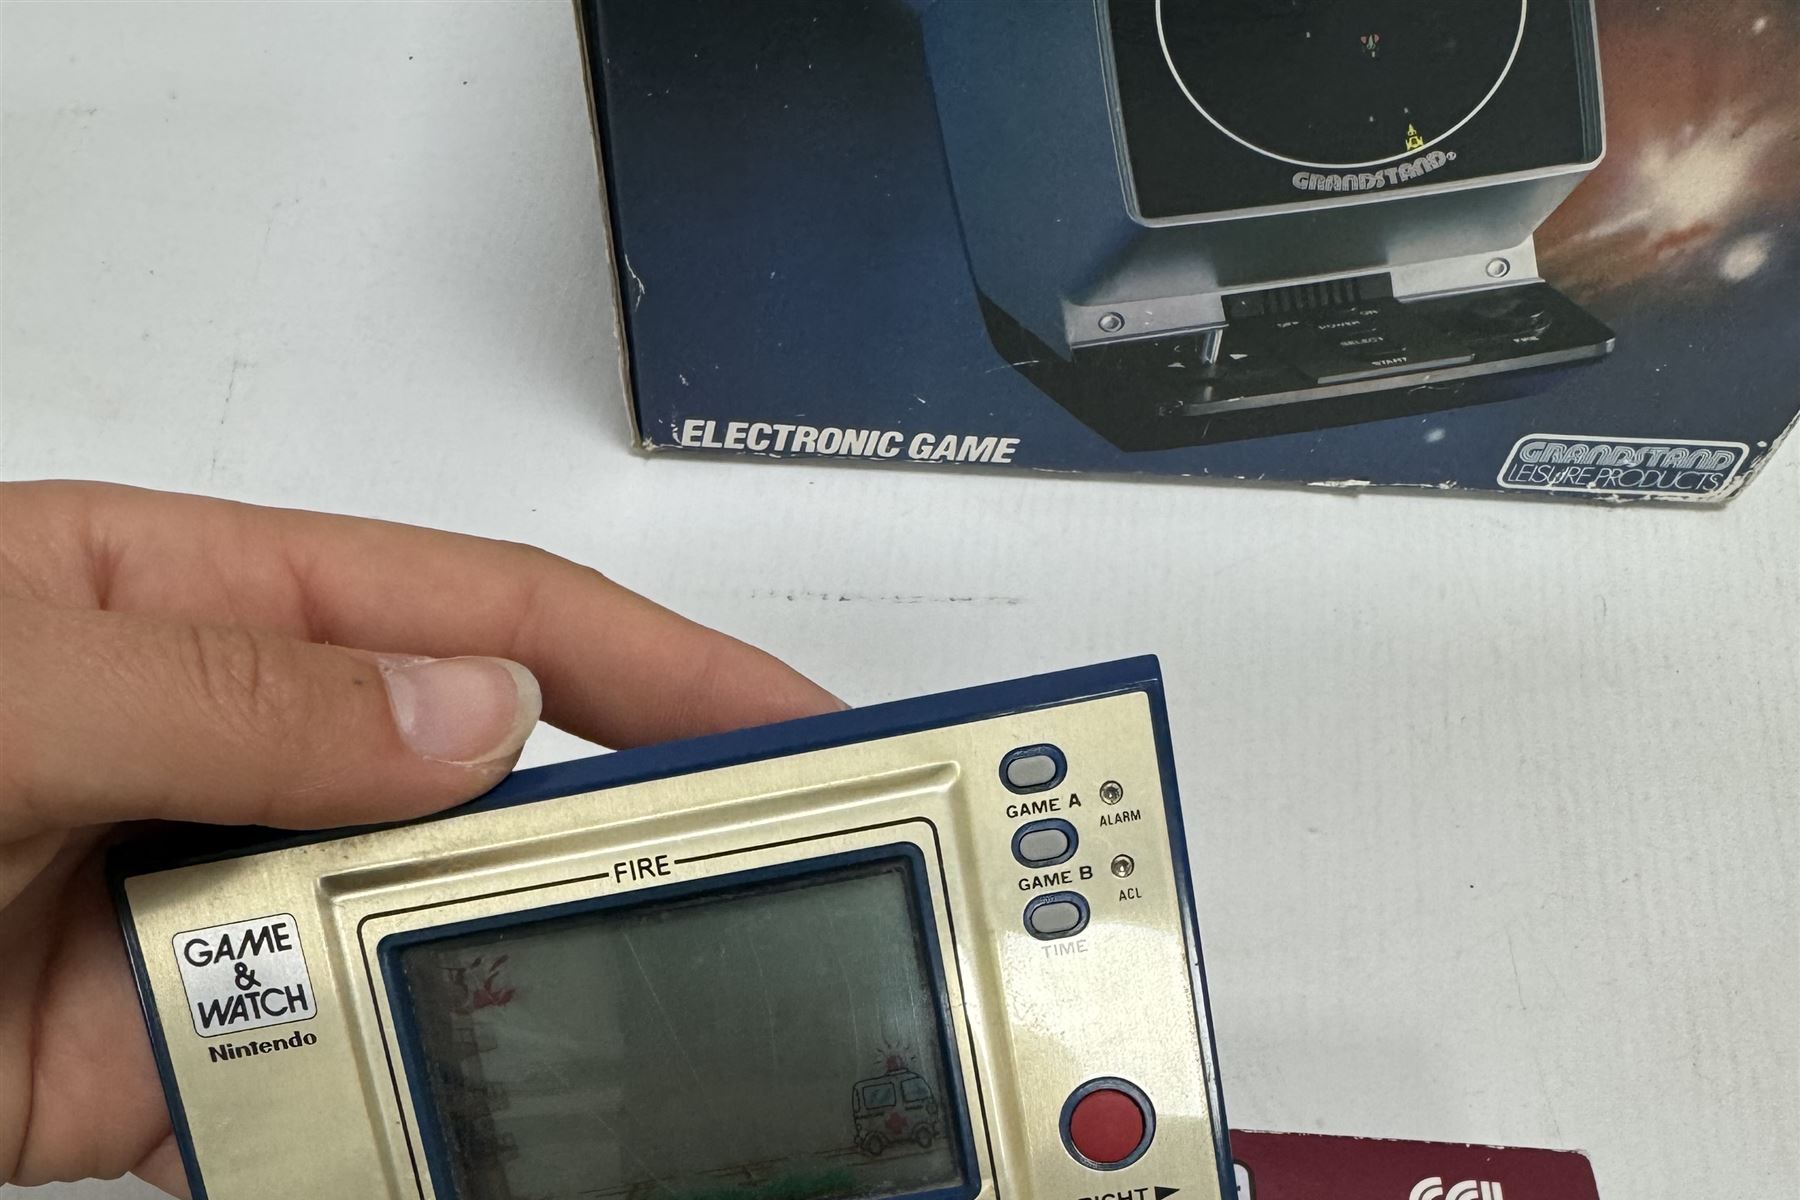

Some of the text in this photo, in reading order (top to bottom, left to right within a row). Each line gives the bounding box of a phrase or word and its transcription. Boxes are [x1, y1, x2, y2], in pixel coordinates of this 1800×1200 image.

[681, 419, 1021, 463] ELECTRONIC GAME
[1519, 441, 1735, 471] GRANDSTAND
[1507, 463, 1724, 491] LEISURE PRODUCTS
[1006, 793, 1082, 819] GAME A
[1099, 809, 1142, 827] ALARM
[613, 854, 671, 883] FIRE
[1018, 865, 1094, 891] GAME B
[1118, 888, 1142, 901] ACL
[184, 922, 292, 967] GAME
[1041, 939, 1088, 959] TIME
[234, 962, 262, 990] &
[197, 983, 308, 1029] WATCH
[208, 1031, 317, 1063] Nintendo
